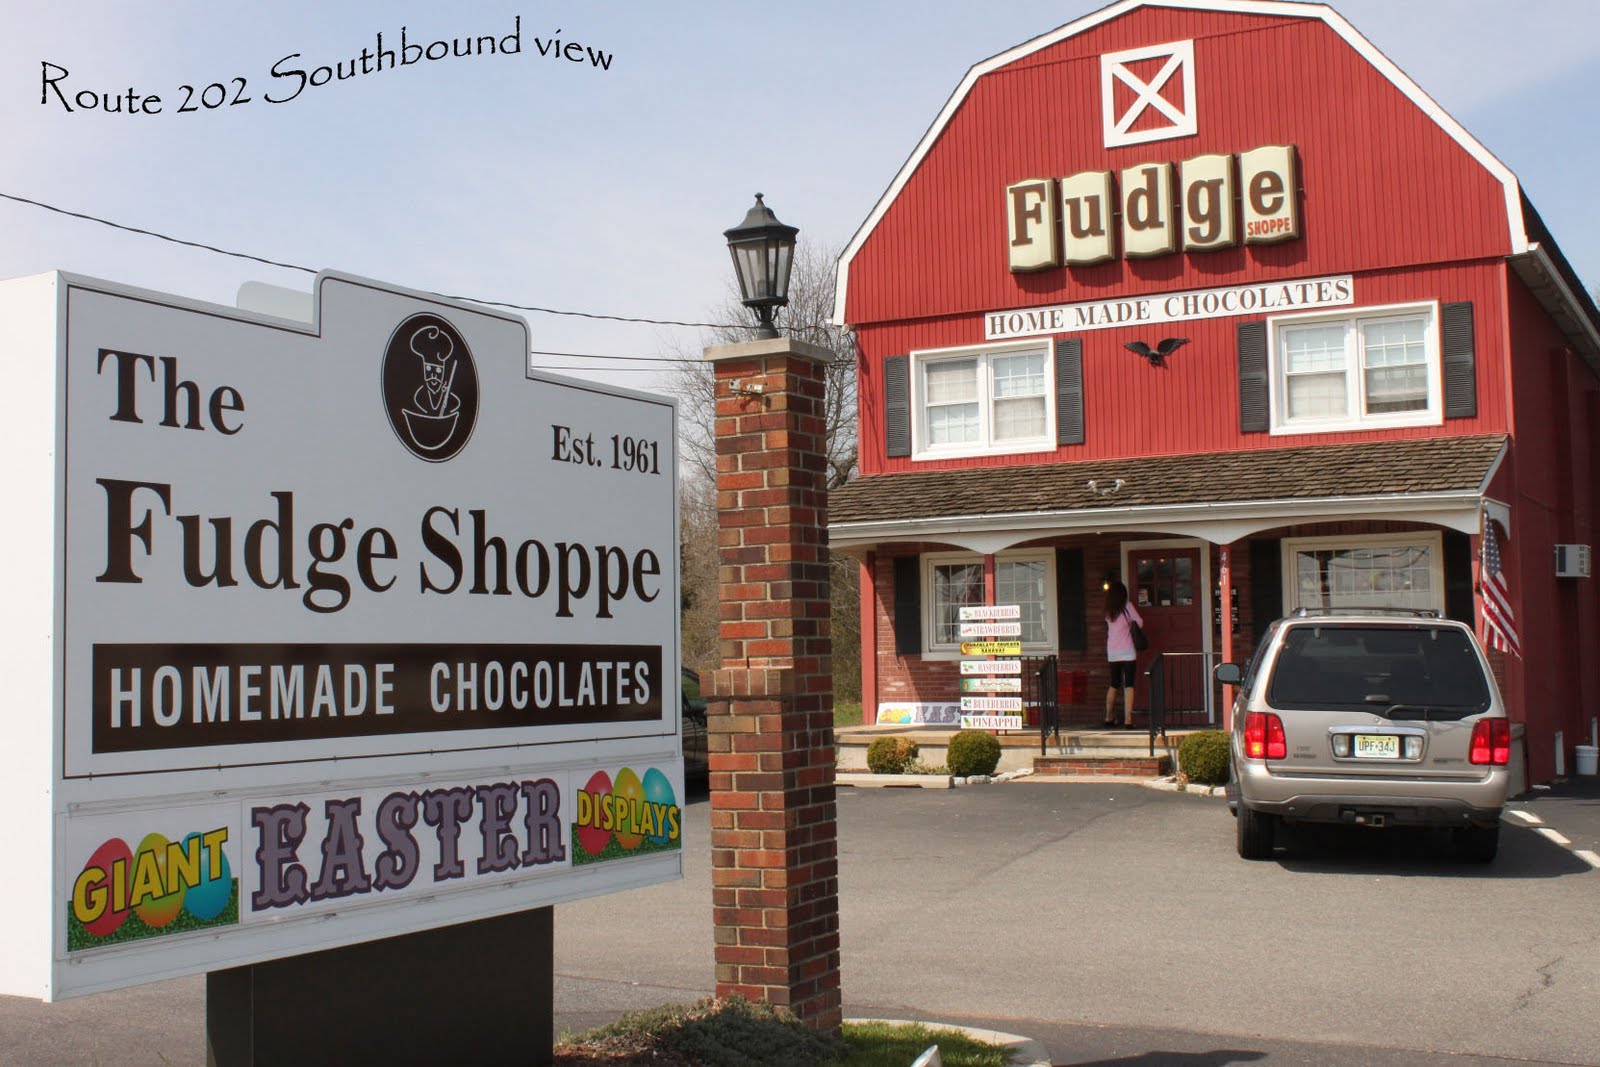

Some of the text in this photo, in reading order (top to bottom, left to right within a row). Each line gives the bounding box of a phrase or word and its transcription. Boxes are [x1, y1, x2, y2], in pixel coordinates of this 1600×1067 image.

[1009, 166, 1285, 245] Fudge
[1247, 216, 1291, 236] SHOPPE
[989, 278, 1350, 336] HOME MADE CHOCOLATES
[96, 347, 246, 436] The
[550, 423, 662, 475] Est. 1961
[95, 477, 662, 619] Fudge Shoppe
[973, 624, 1020, 635] STRAWBERRIES
[110, 660, 651, 729] HOMEMADE CHOCOLATES
[972, 717, 1020, 728] PINEAPPLE
[974, 698, 1020, 709] BLUEBERRIES
[72, 777, 681, 925] GIANT EASTER DISPLAYS
